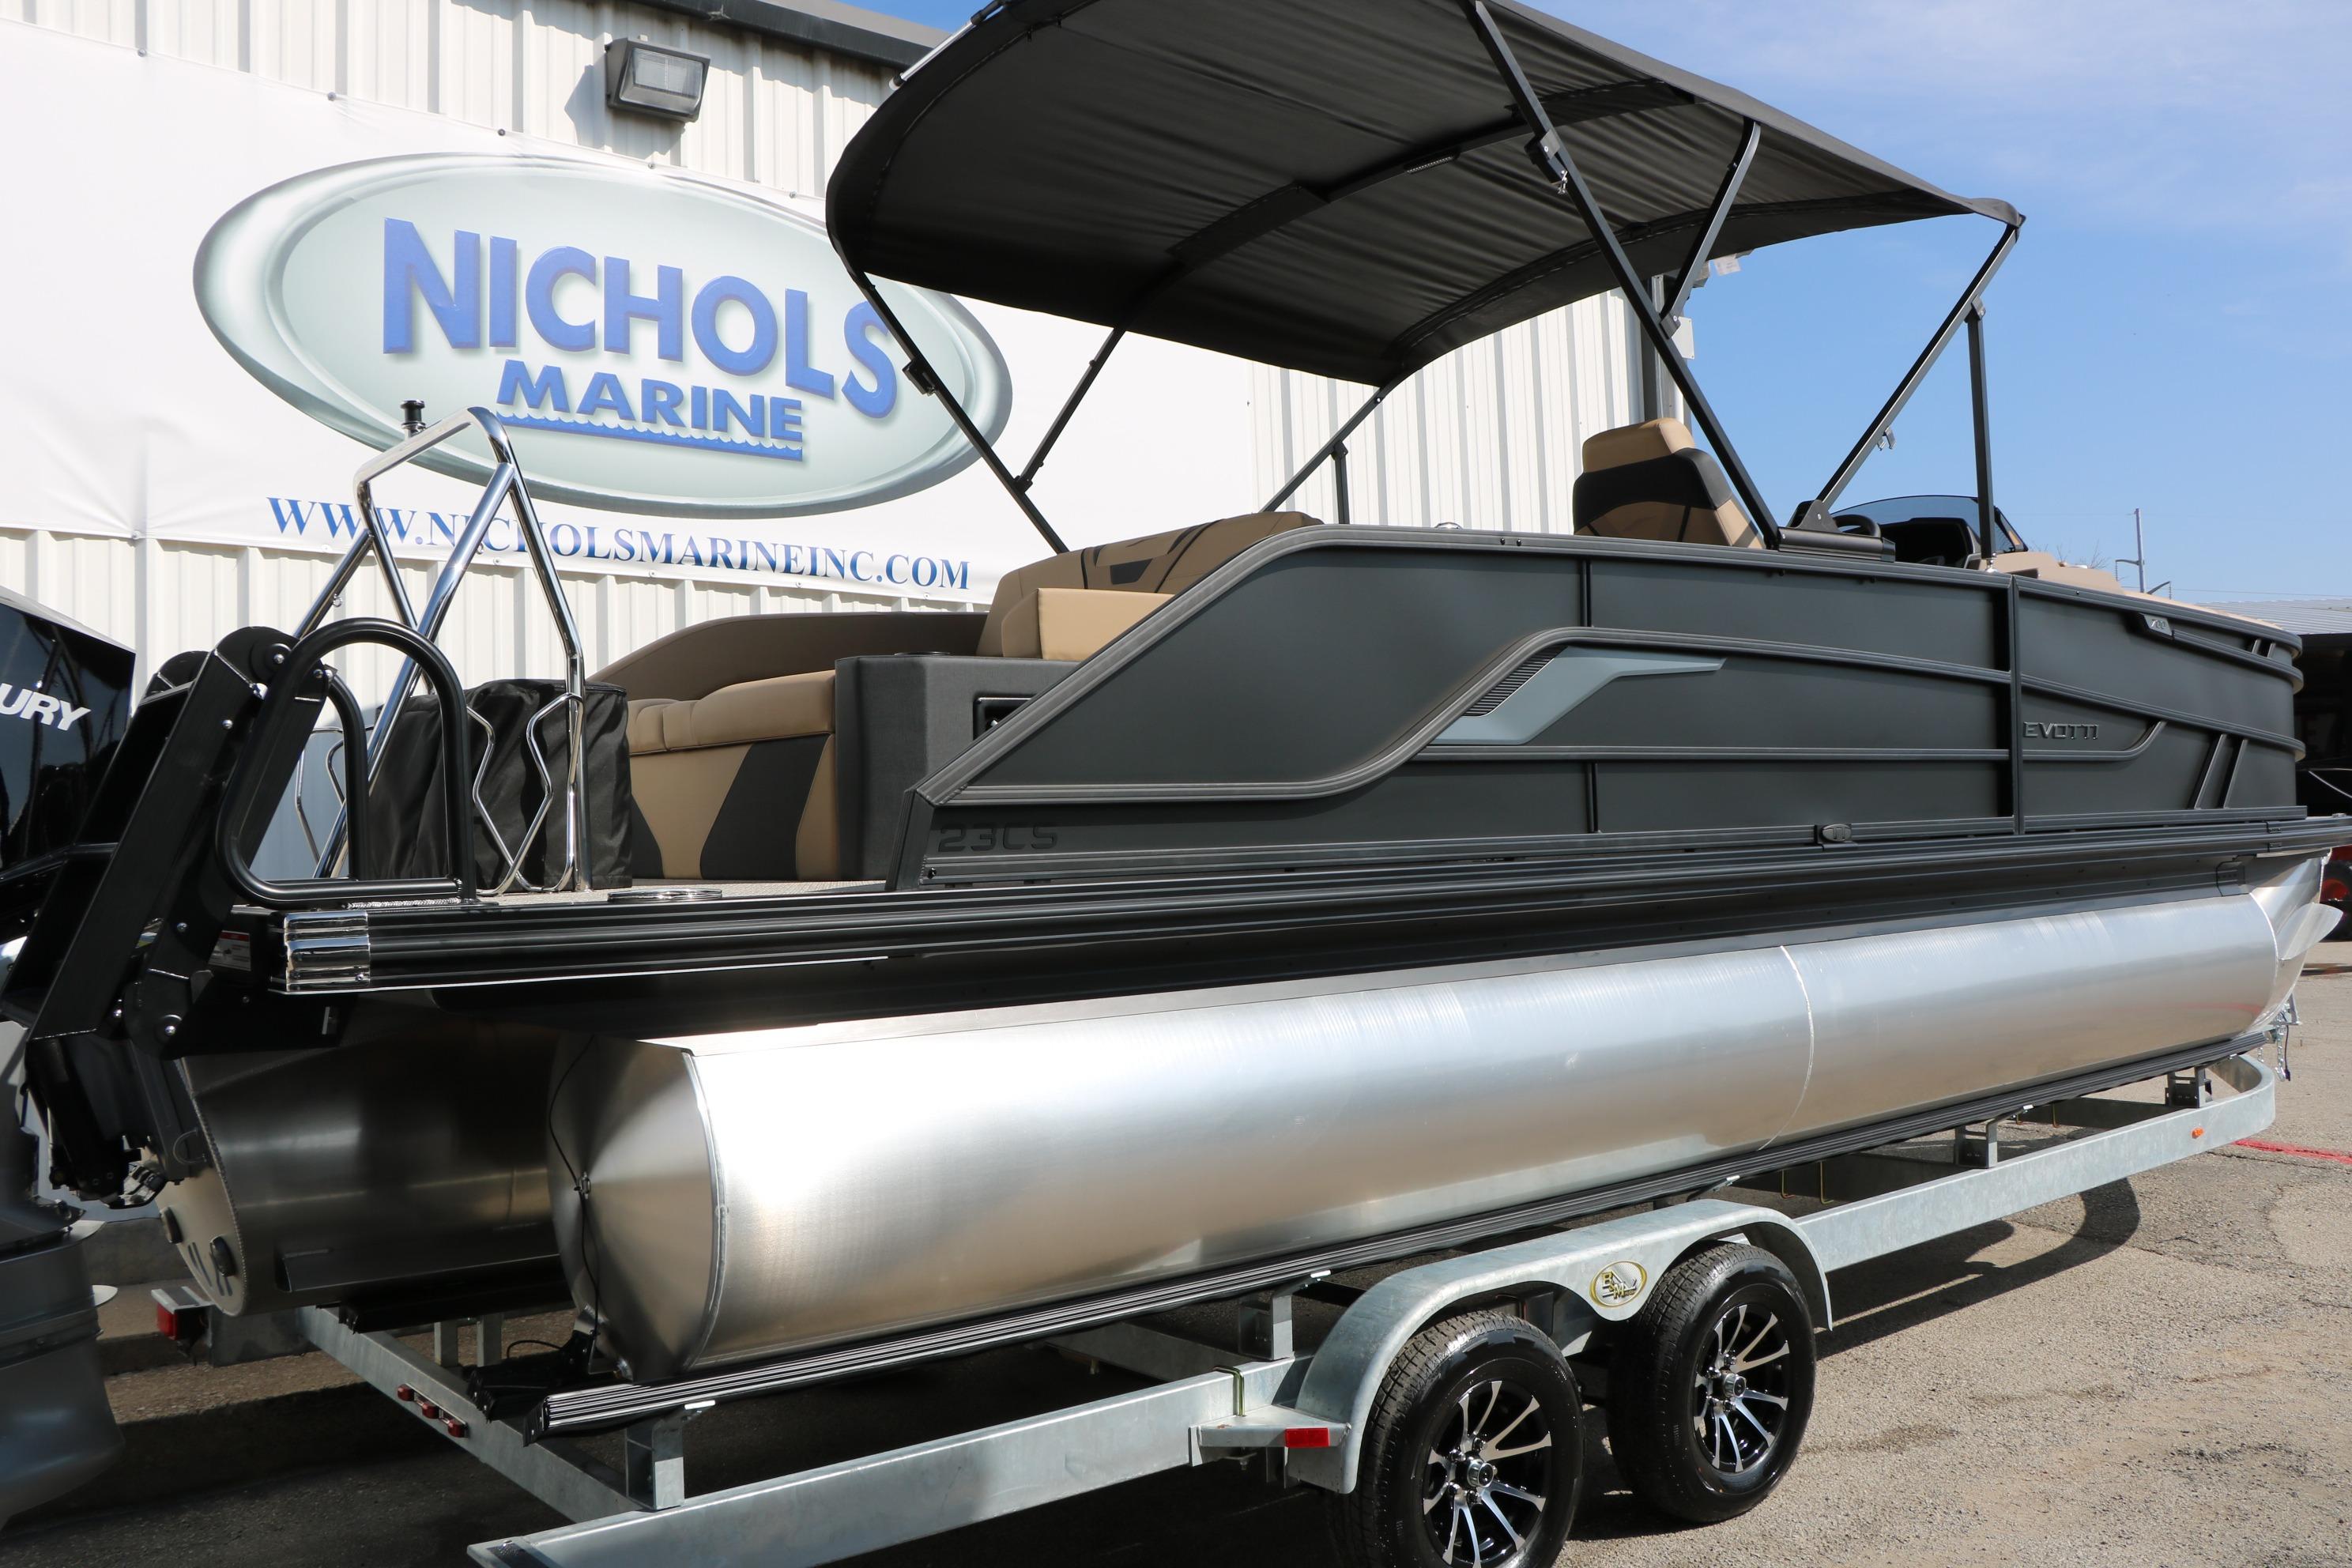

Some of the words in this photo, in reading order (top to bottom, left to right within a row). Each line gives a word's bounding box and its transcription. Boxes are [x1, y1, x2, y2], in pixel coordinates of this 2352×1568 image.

[383, 217, 898, 419] NICHOLS
[496, 359, 803, 443] MARINE
[266, 496, 971, 590] WWW.NCOLSMARINEINC.COM
[2023, 722, 2100, 740] EVOTTI
[938, 823, 1057, 853] 23CS
